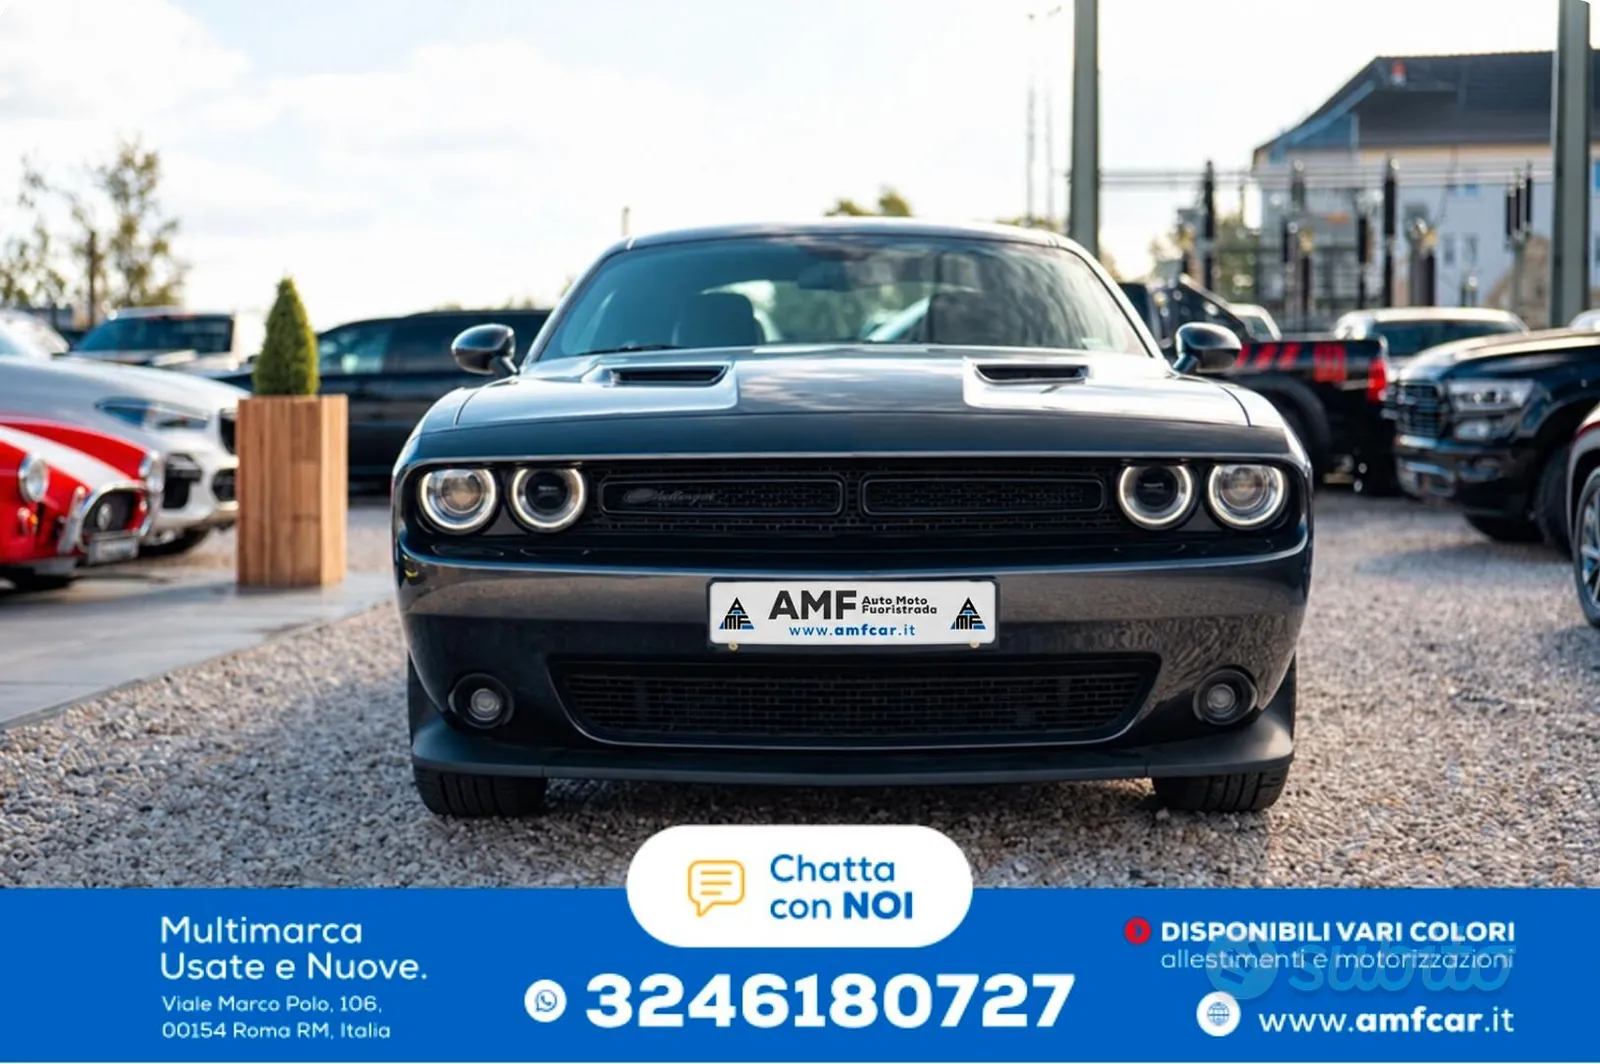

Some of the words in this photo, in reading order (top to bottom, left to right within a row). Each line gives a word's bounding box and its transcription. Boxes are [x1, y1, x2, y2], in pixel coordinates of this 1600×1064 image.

[768, 590, 857, 620] AMF
[861, 595, 893, 606] Auto
[896, 595, 929, 606] Moto
[861, 605, 938, 615] Fuoristrada
[788, 623, 916, 636] www.amfcar.it
